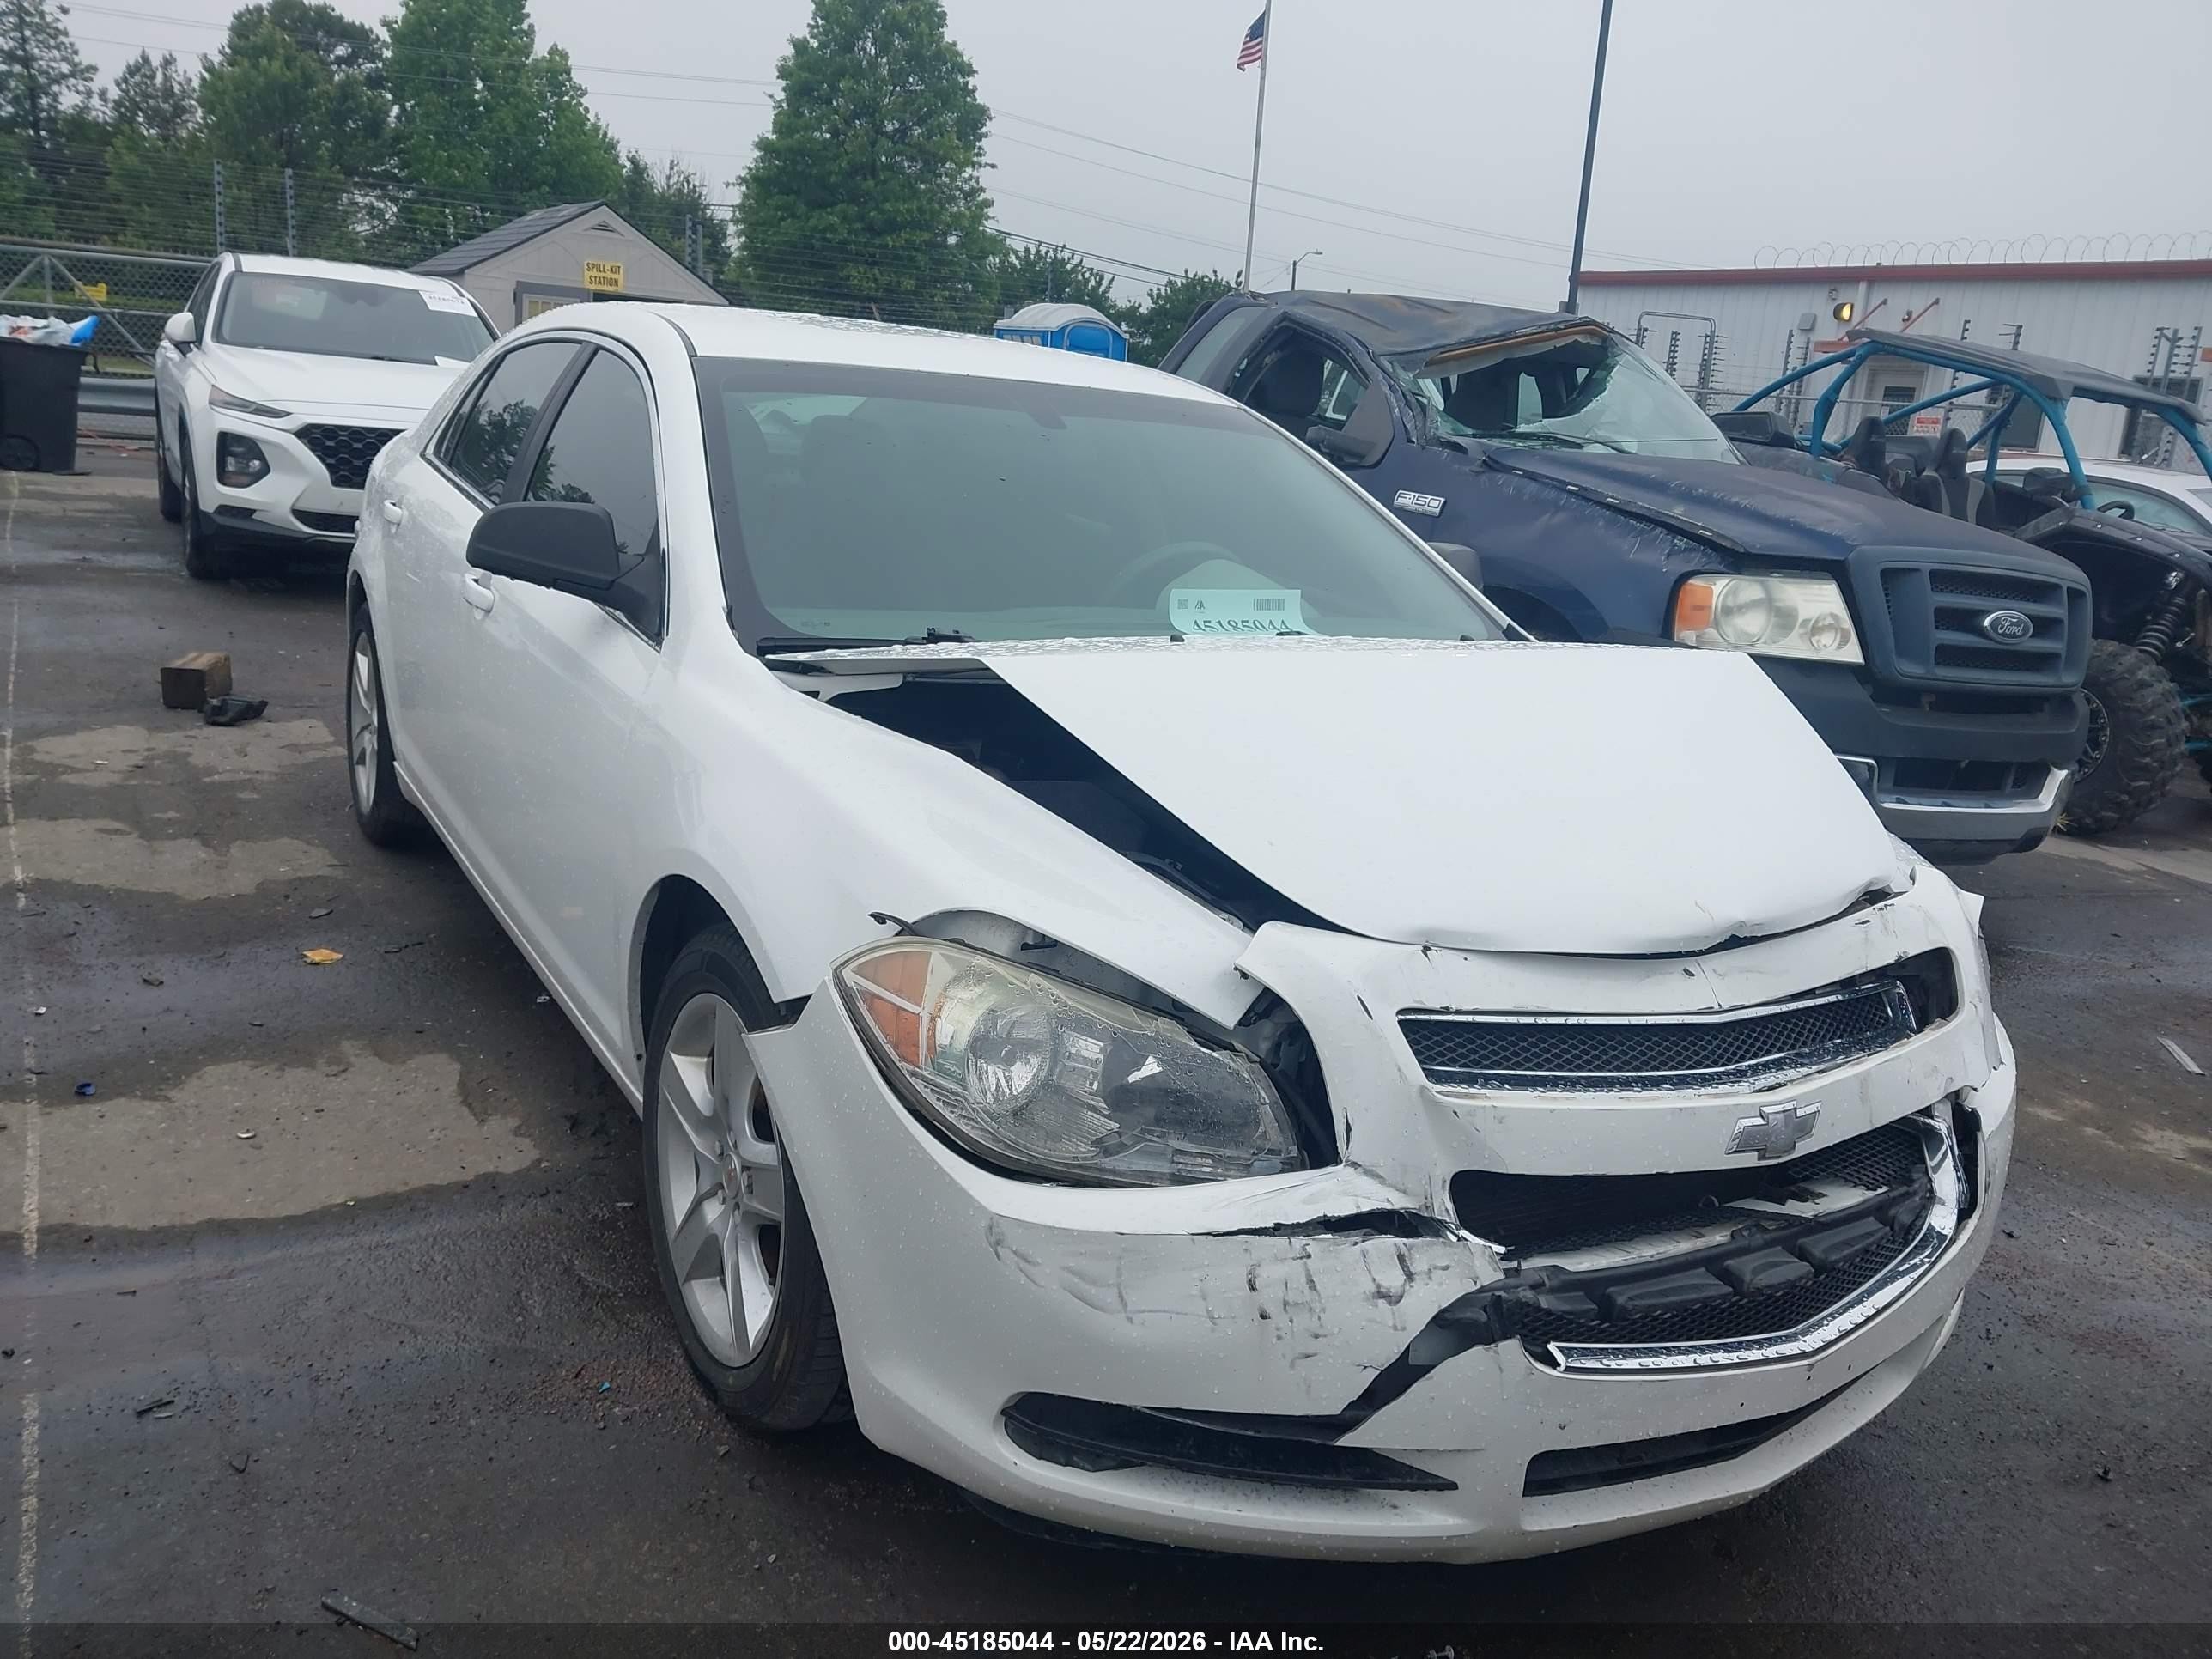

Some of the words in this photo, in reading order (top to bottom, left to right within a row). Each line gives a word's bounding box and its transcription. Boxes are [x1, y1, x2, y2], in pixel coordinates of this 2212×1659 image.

[586, 262, 621, 275] SPILL-KIT
[589, 276, 619, 288] STATION
[1396, 492, 1443, 509] F-150
[1193, 619, 1293, 632] 45185044
[1997, 617, 2024, 635] Ford
